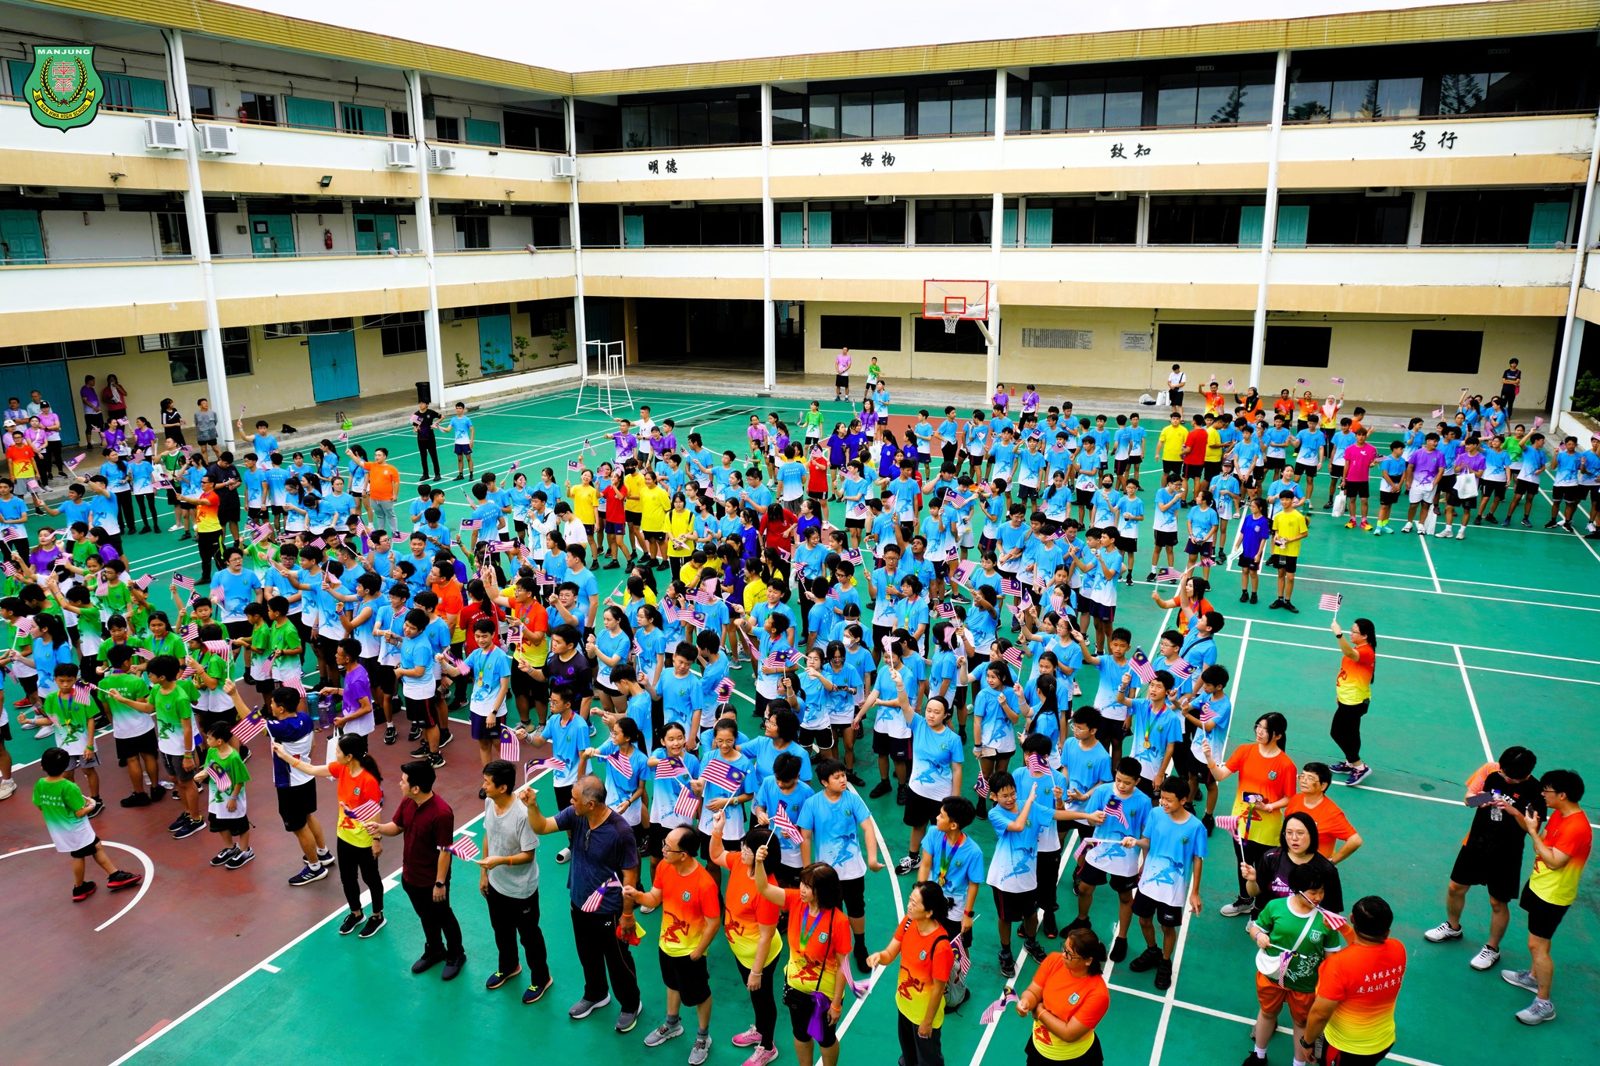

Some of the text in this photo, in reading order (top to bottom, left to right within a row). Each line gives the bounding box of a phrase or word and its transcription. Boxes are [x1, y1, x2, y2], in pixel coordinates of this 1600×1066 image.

[860, 151, 896, 167] 格物
[1110, 142, 1151, 159] 致知
[648, 157, 678, 174] 明德
